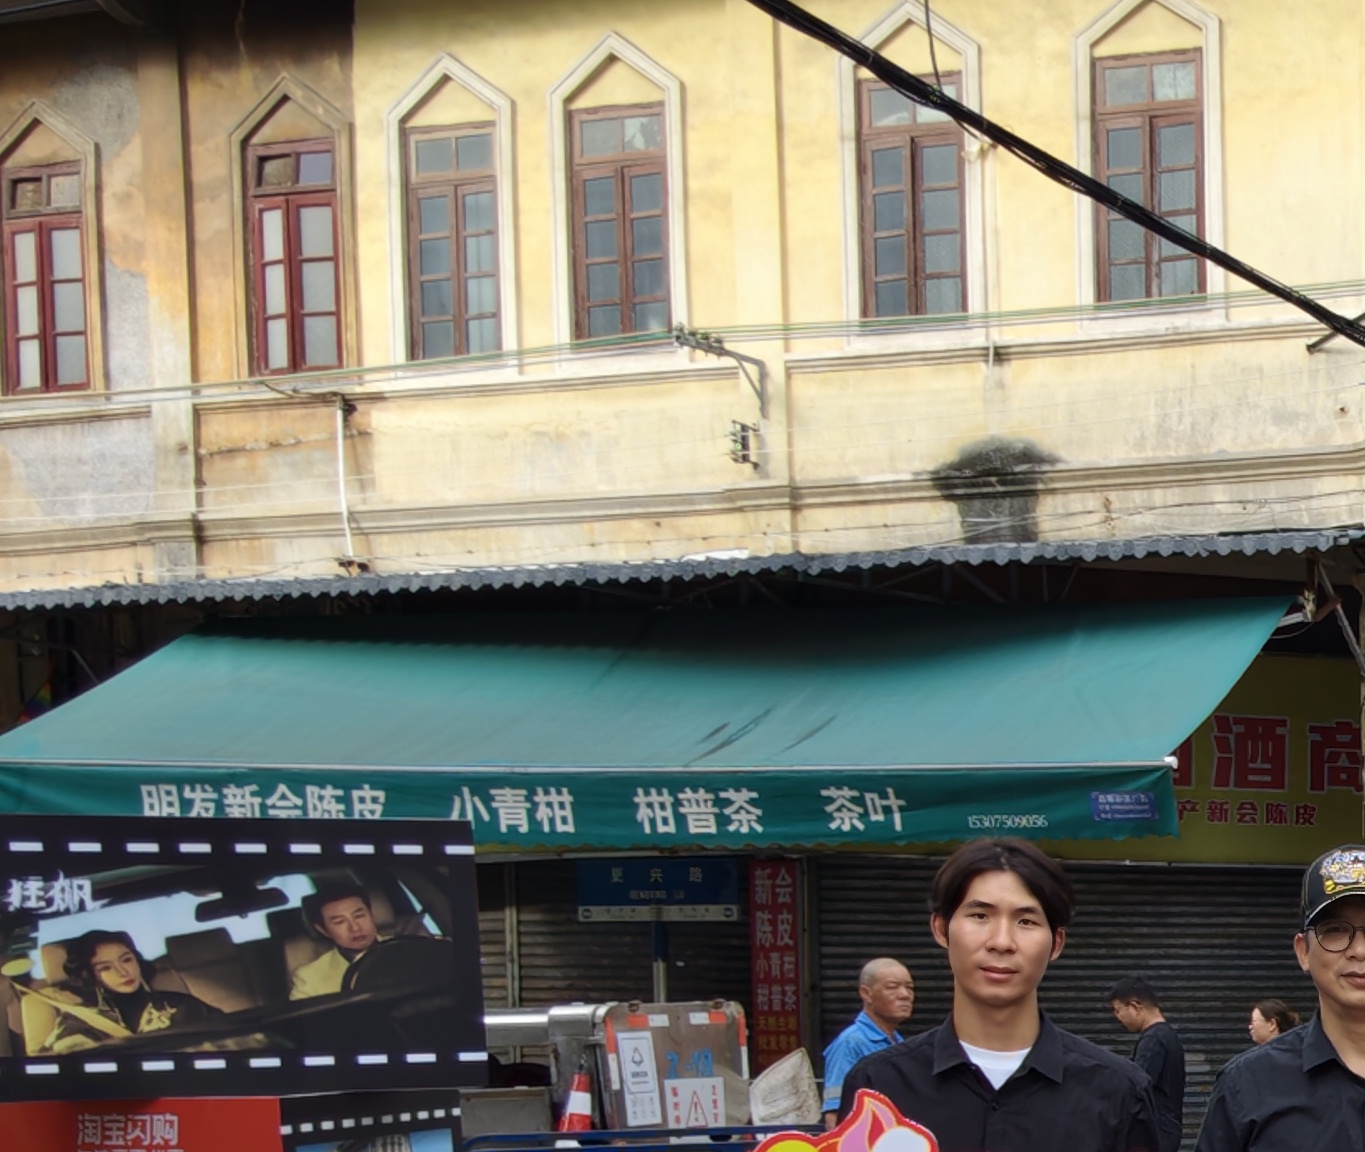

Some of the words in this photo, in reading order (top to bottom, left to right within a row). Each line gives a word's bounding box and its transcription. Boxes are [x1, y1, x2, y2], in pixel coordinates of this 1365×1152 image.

[141, 784, 386, 819] 明发新会陈皮
[449, 786, 575, 835] 小青柑
[633, 787, 764, 836] 柑普茶
[820, 786, 909, 833] 茶叶
[754, 867, 795, 906] 新会
[755, 909, 796, 948] 陈皮
[756, 951, 797, 979] 小青柑
[756, 983, 798, 1012] 柑普茶
[77, 1113, 179, 1147] 淘宝闪购
